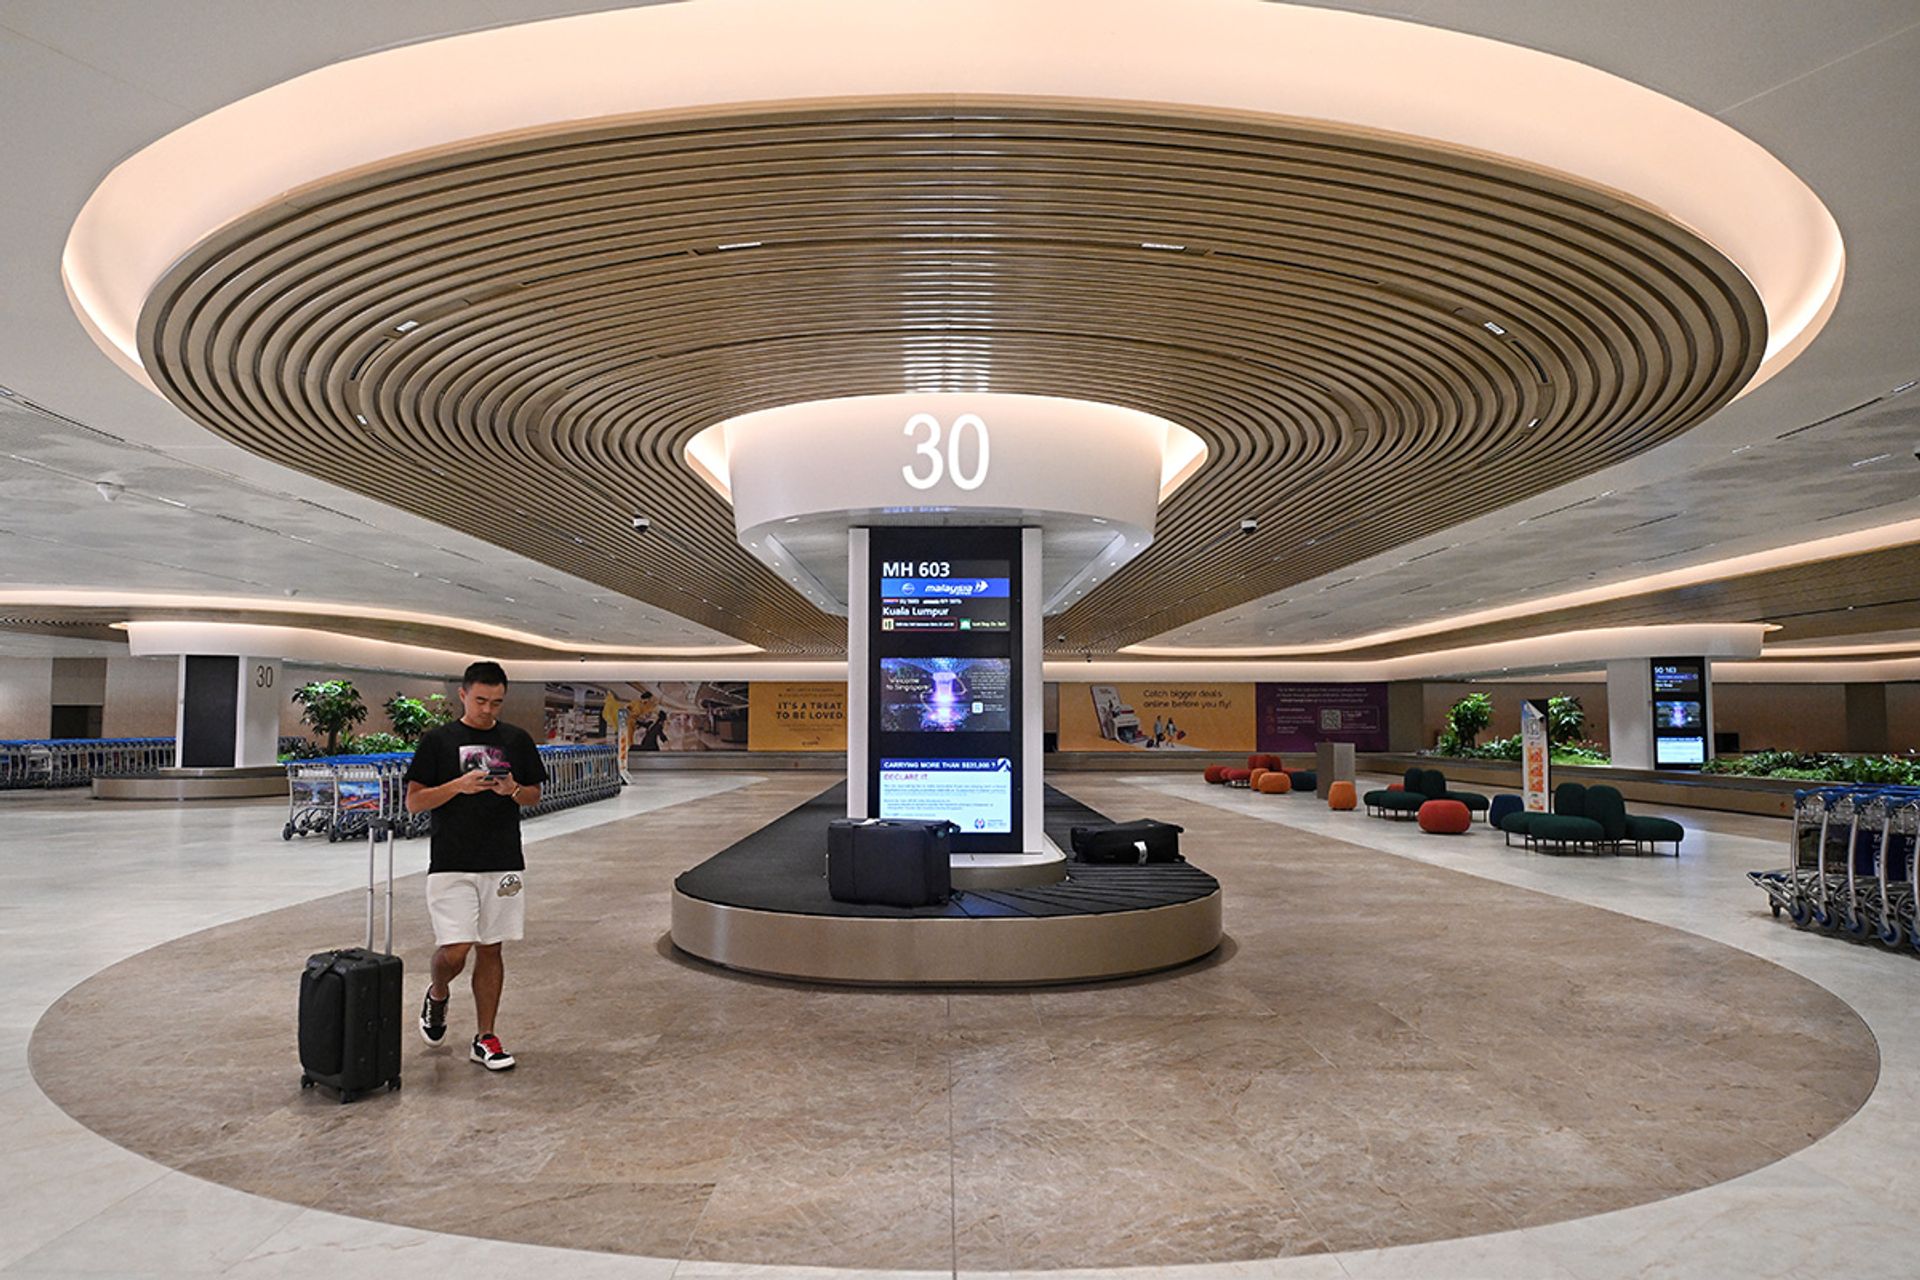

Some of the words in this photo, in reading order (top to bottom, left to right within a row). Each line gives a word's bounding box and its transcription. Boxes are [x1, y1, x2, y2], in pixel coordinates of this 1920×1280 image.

[902, 413, 989, 490] 30
[883, 562, 913, 577] MH
[918, 562, 950, 577] 603
[925, 584, 973, 595] malaysia
[882, 607, 910, 616] Kuala
[912, 607, 949, 617] Lumpur
[256, 665, 273, 688] 30
[1143, 690, 1167, 698] Catch
[1170, 690, 1197, 700] bigger
[1199, 690, 1222, 698] deals
[778, 702, 798, 710] IT'S
[801, 702, 808, 710] A
[810, 702, 842, 710] TREAT
[1143, 700, 1169, 708] online
[1171, 700, 1200, 708] before
[1219, 700, 1232, 709] fly!
[777, 711, 790, 719] TO
[792, 711, 806, 719] BE
[883, 761, 919, 769] CARRYING
[920, 761, 940, 769] MORE
[942, 761, 960, 769] THAN
